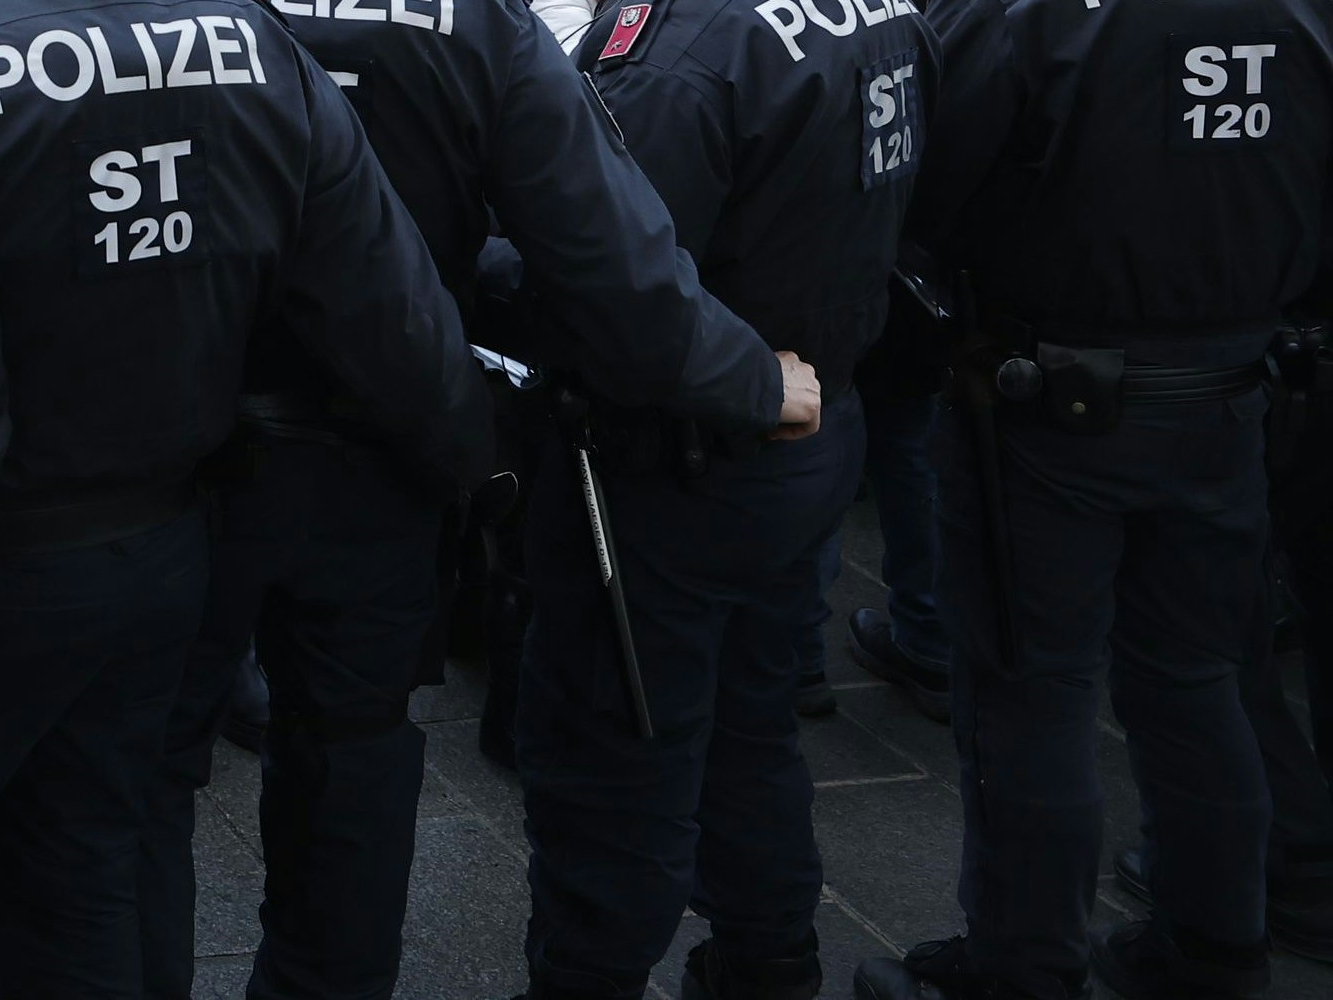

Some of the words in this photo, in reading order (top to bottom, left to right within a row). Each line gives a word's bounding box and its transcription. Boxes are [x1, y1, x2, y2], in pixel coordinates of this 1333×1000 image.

[869, 63, 914, 129] ST
[1182, 43, 1277, 97] ST
[1183, 101, 1271, 140] 120
[88, 139, 192, 213] ST
[869, 122, 913, 175] 120
[94, 209, 194, 265] 120
